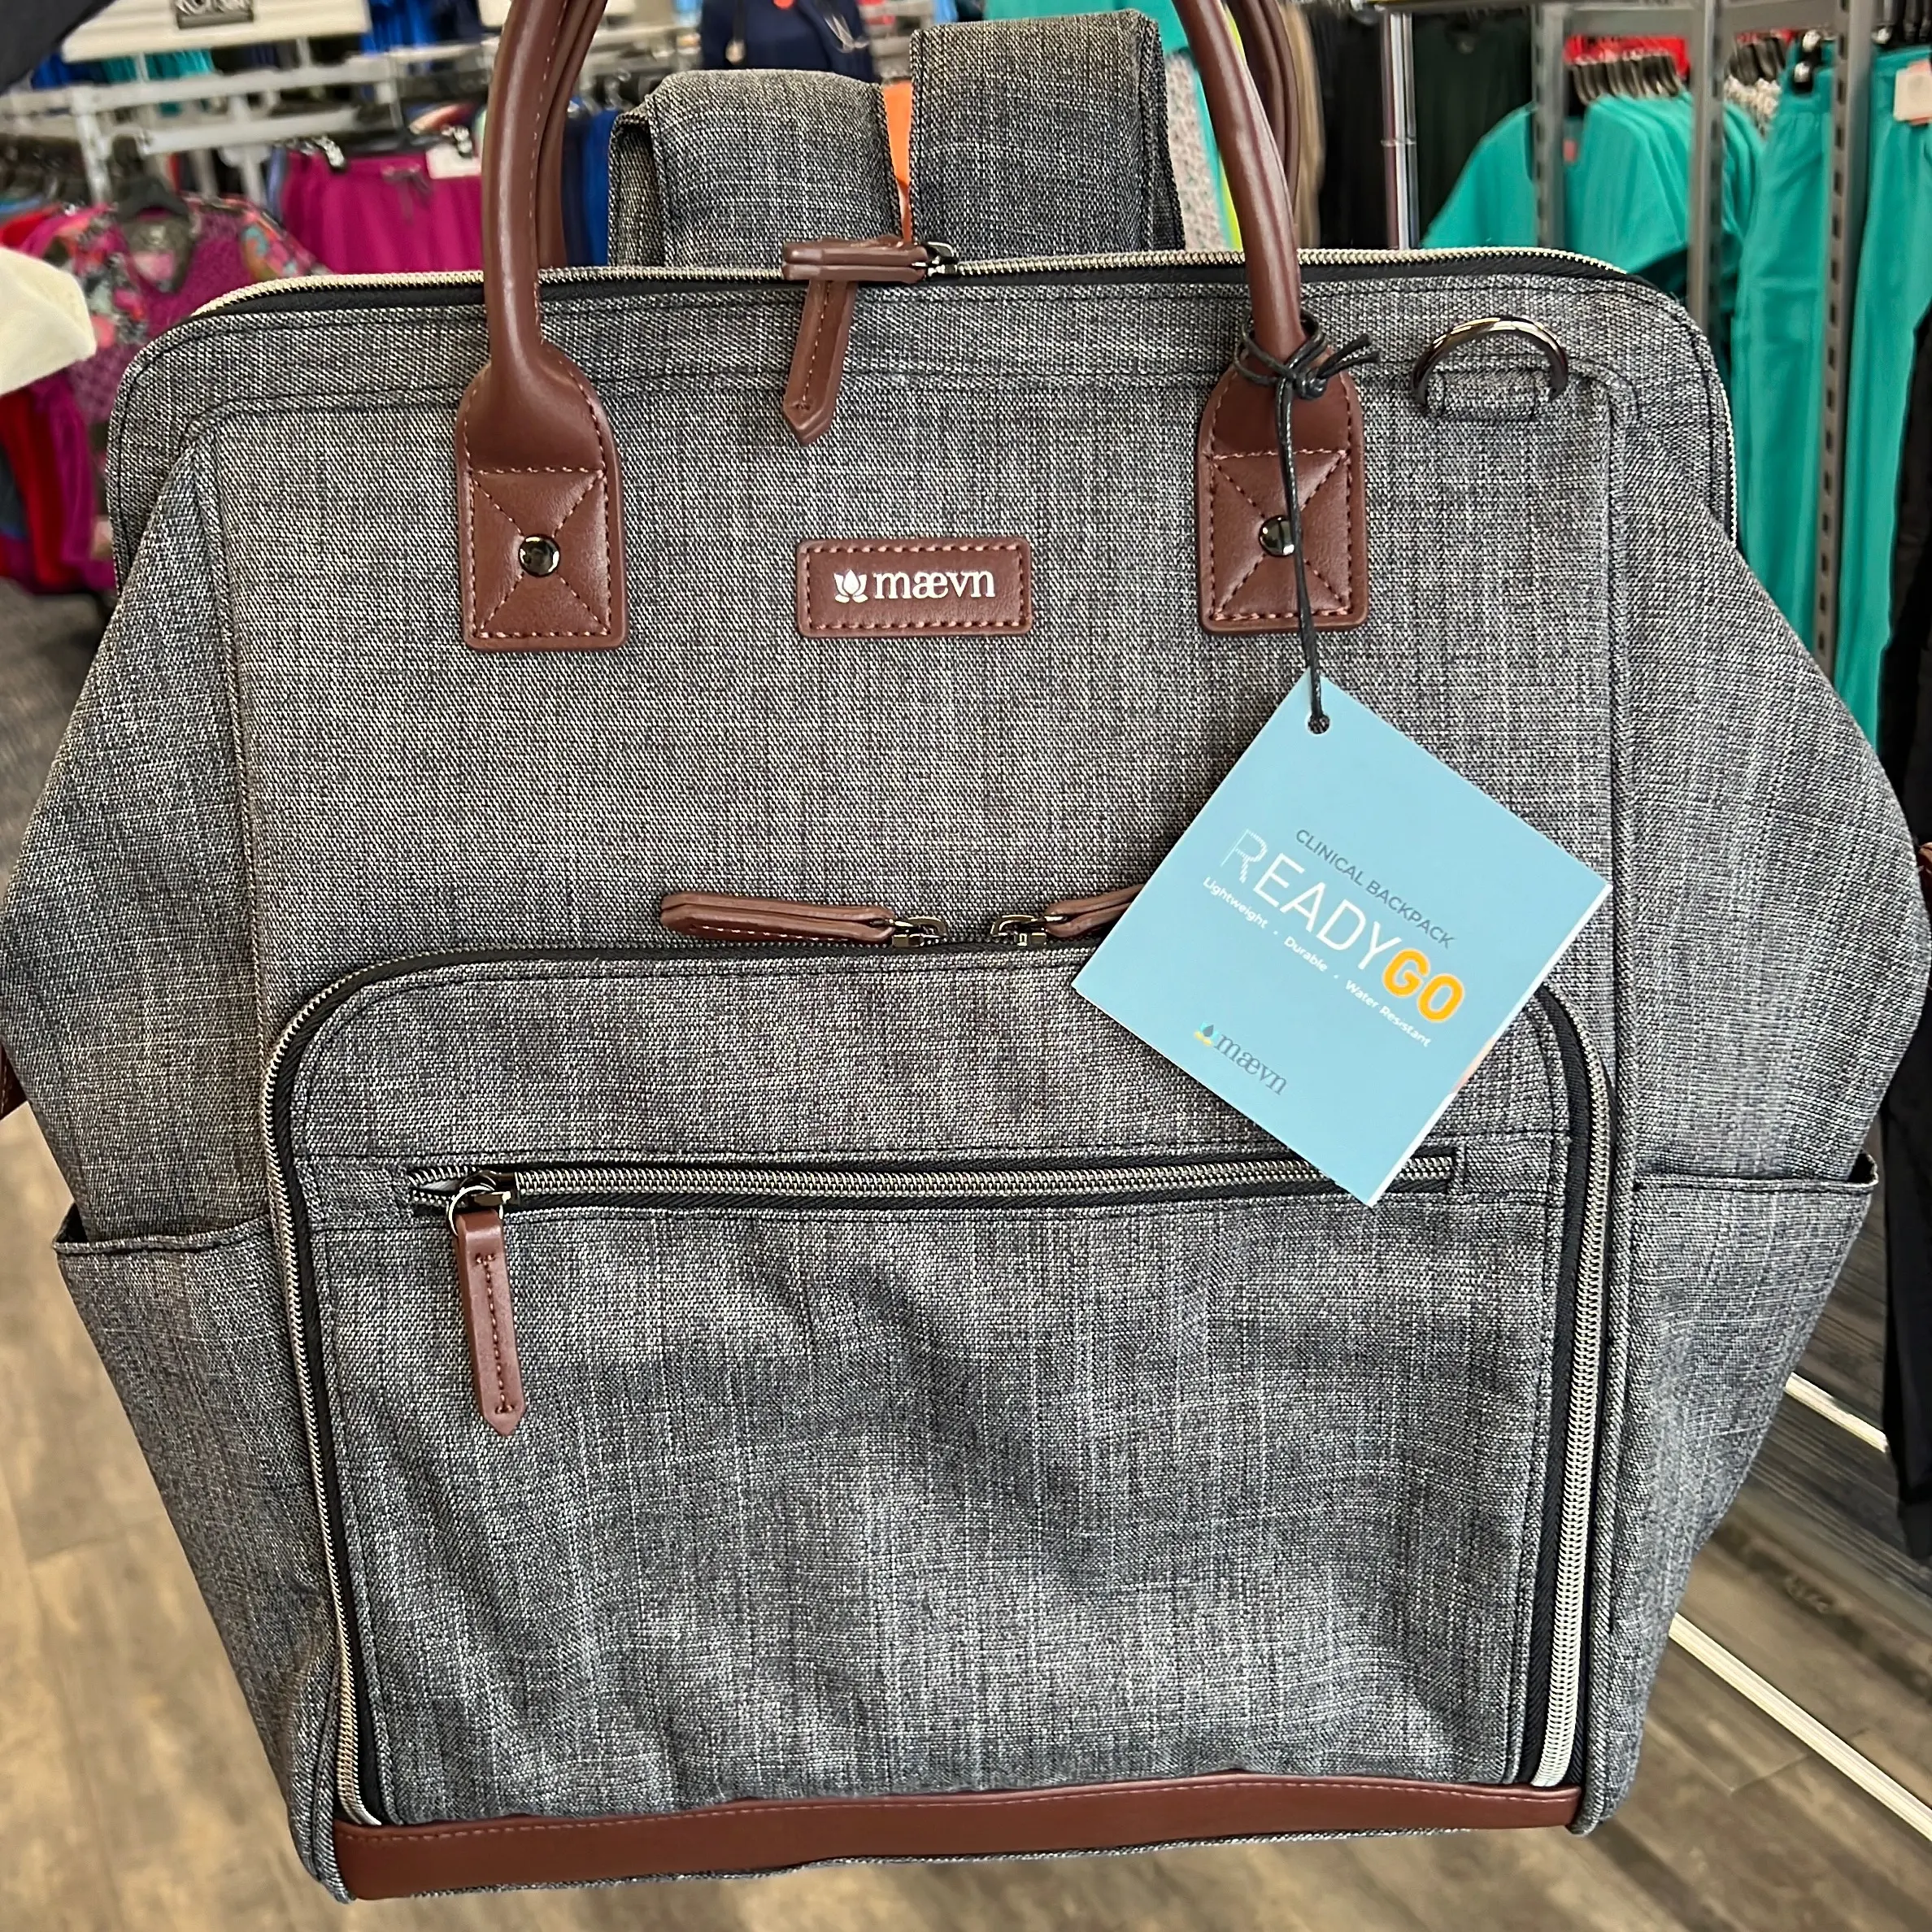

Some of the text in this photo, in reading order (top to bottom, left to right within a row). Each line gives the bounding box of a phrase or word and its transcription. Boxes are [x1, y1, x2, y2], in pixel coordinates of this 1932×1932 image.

[872, 570, 996, 599] mævn
[1203, 876, 1268, 929] Lightweight
[1284, 935, 1328, 972] Durable
[1295, 829, 1456, 949] CLINICAL BACKPACK
[1213, 1033, 1287, 1095] mævn
